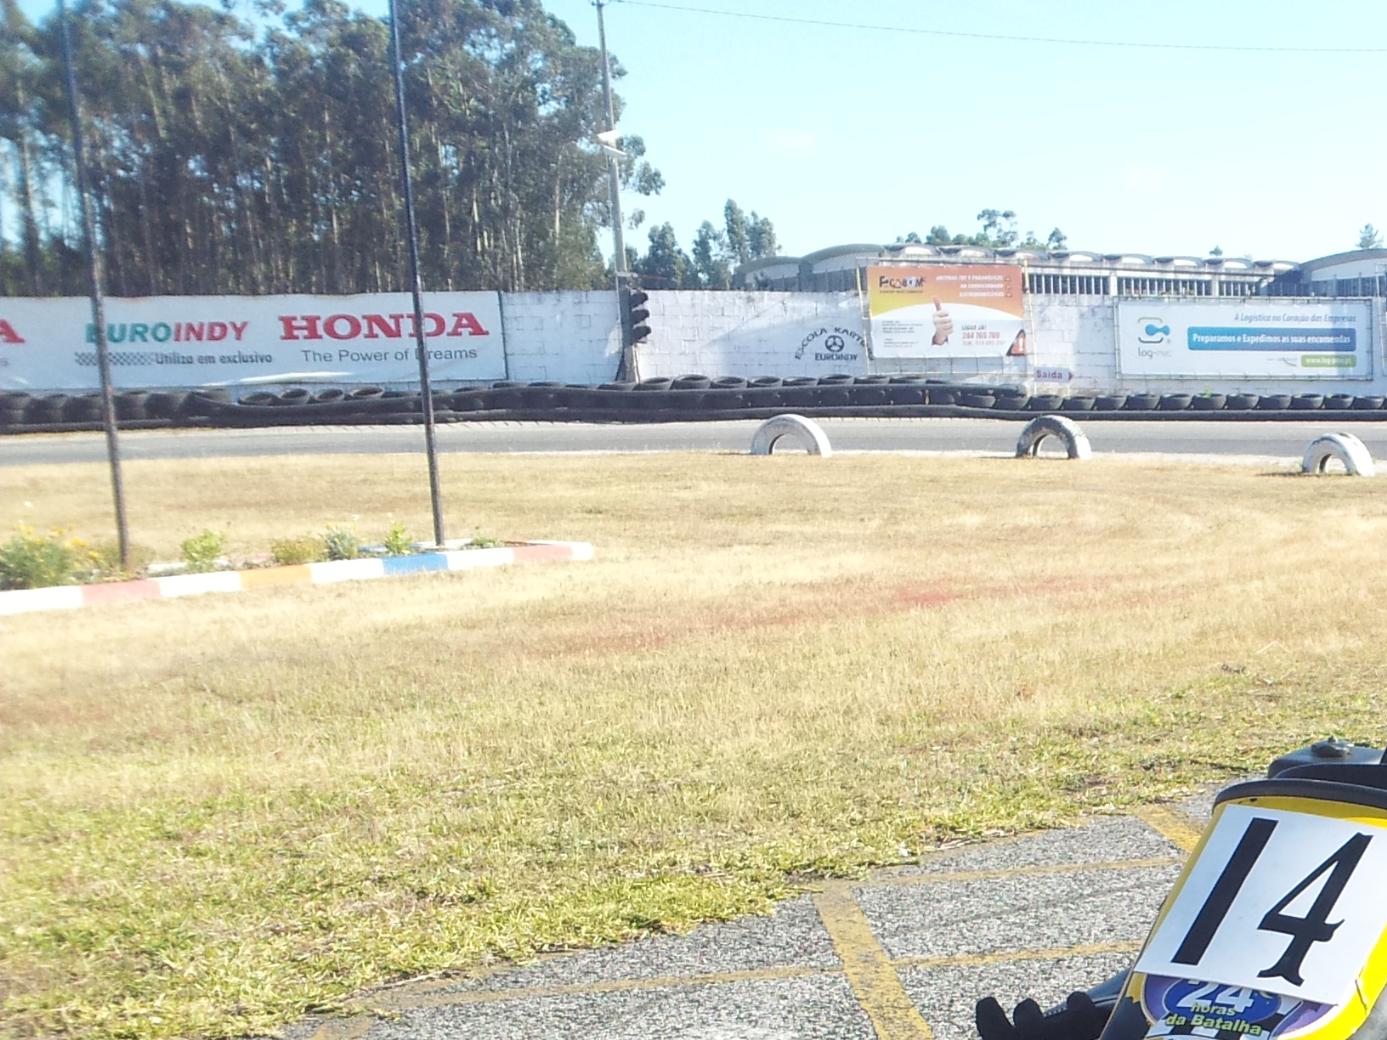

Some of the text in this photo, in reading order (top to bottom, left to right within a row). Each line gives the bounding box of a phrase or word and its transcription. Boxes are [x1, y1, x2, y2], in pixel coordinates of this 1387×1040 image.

[278, 312, 489, 340] HONDA
[220, 350, 272, 364] exclusivo
[302, 350, 333, 362] The
[339, 349, 389, 362] Power
[394, 348, 410, 361] of
[1170, 816, 1374, 987] 14
[1175, 979, 1255, 1013] 24
[1191, 1002, 1237, 1017] horas
[1165, 1013, 1262, 1036] da Batalha
